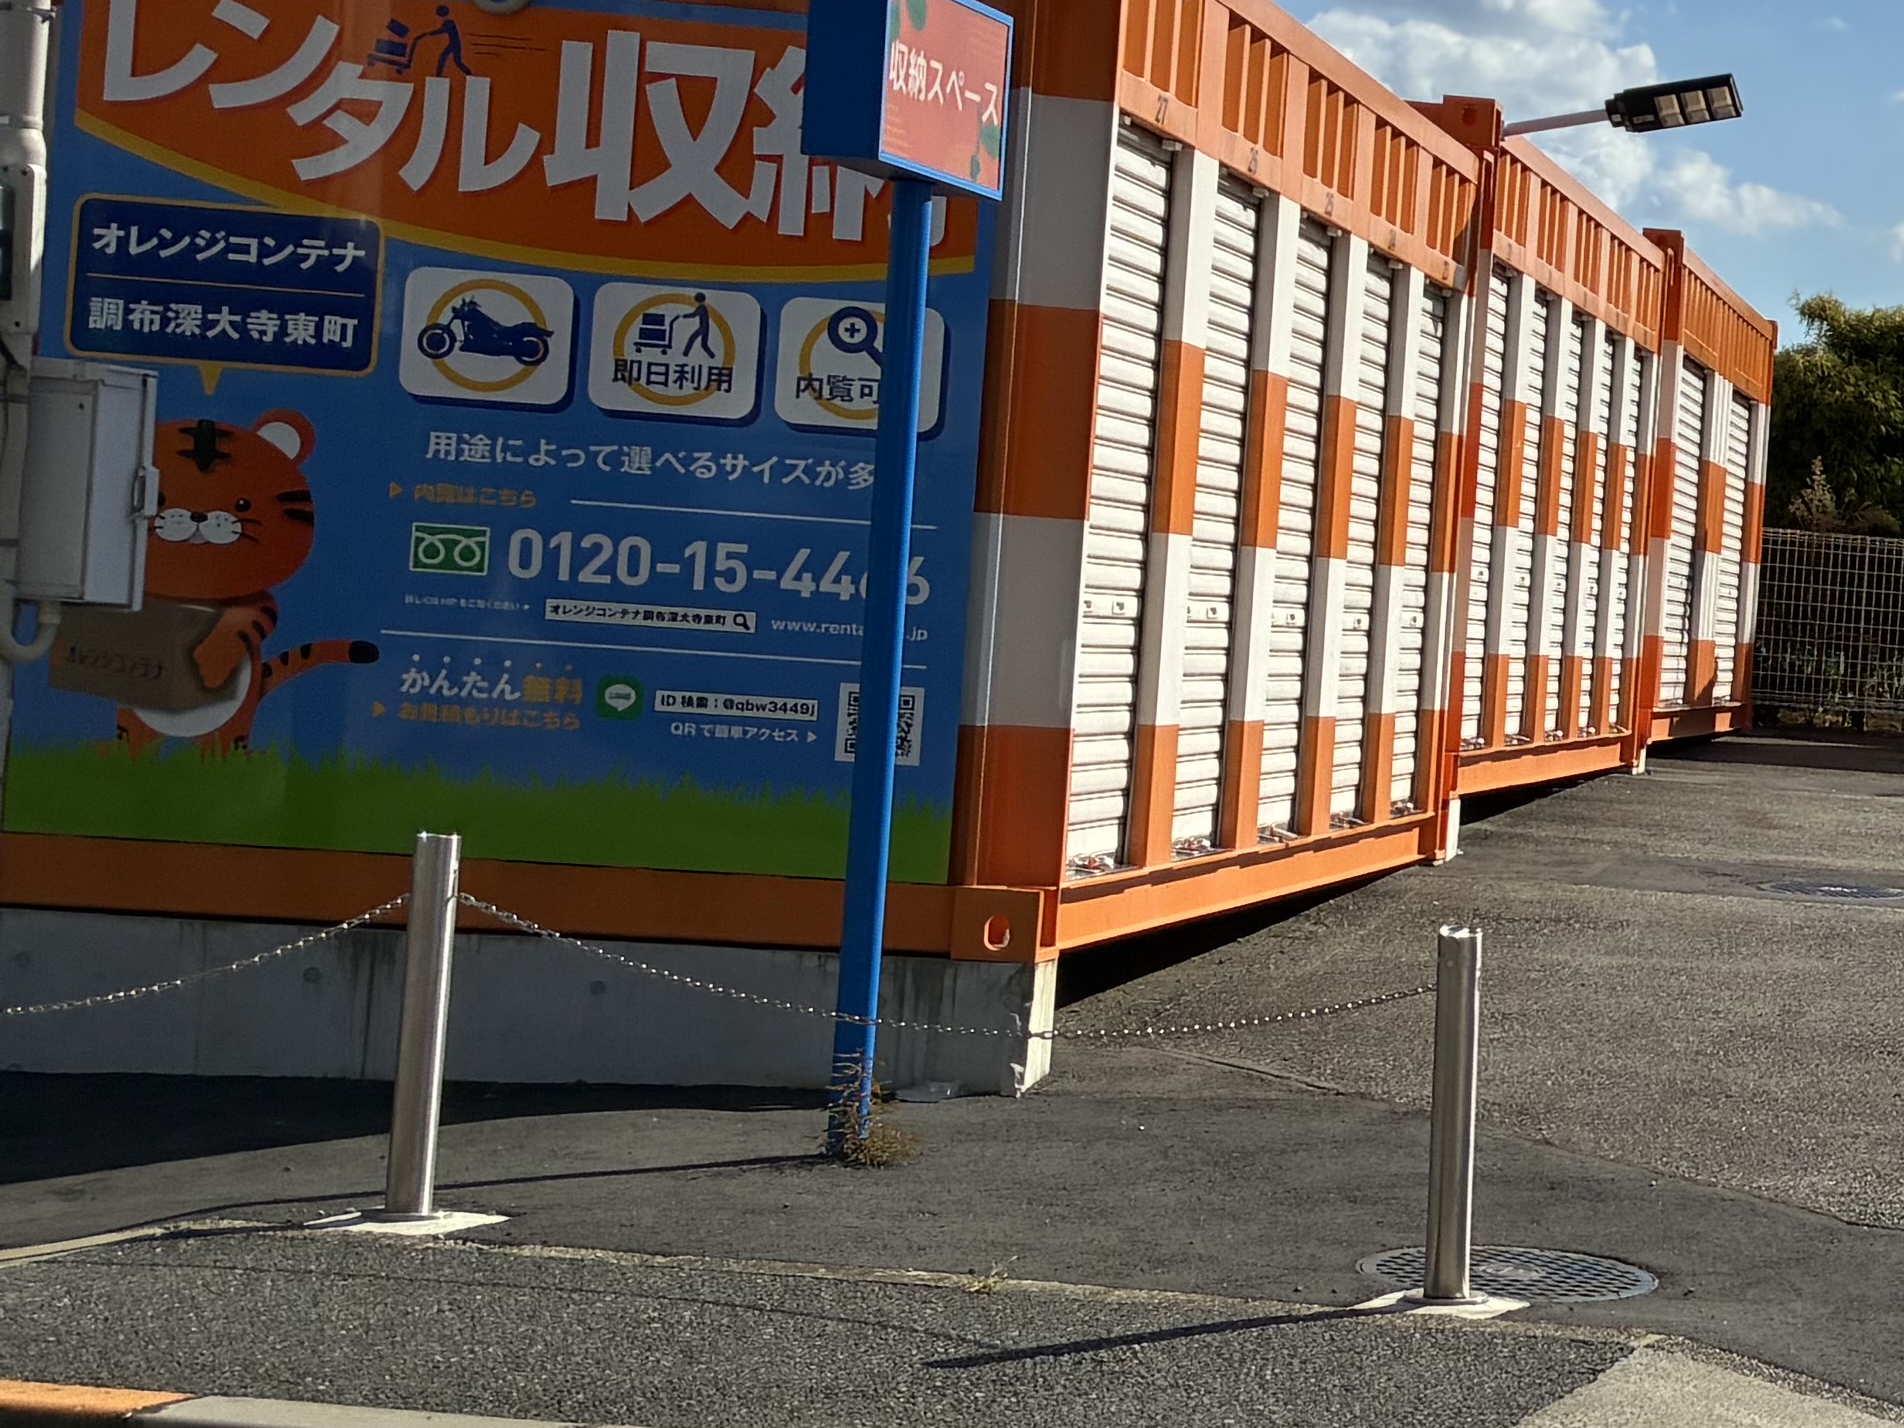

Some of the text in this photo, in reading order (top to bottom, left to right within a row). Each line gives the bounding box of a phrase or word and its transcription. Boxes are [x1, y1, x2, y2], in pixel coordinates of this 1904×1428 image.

[888, 39, 999, 126] 収納スペース
[92, 222, 367, 272] オレンジコンテナ
[88, 296, 359, 348] 調布深大寺東町
[612, 358, 733, 394] 即日利用
[507, 527, 931, 606] 0120-15-446
